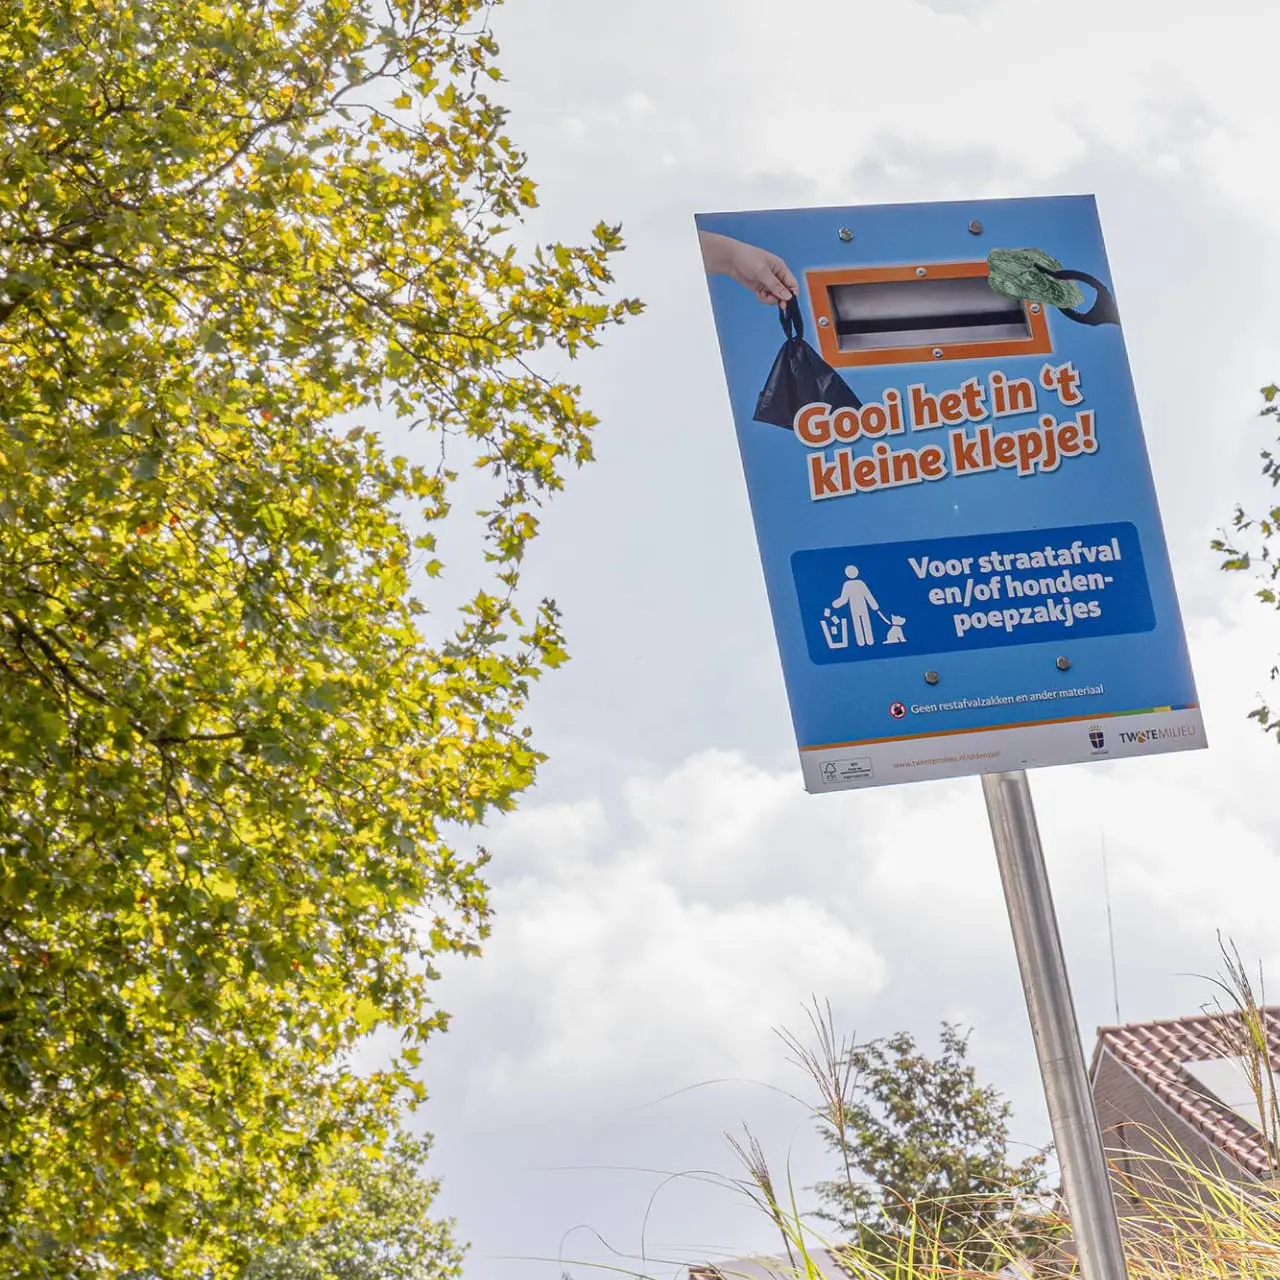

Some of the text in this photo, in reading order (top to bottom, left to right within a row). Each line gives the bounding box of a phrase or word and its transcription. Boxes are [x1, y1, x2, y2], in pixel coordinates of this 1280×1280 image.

[797, 390, 902, 445] Gooi
[909, 380, 984, 428] het
[990, 373, 1034, 415] in
[809, 412, 1096, 497] kleine klepje!
[907, 537, 1122, 579] Voor straatafval
[928, 569, 1114, 607] en/of honden-
[953, 596, 1102, 638] poepzakjes
[910, 684, 1104, 714] Geen restafvalzakken en ander materiaal
